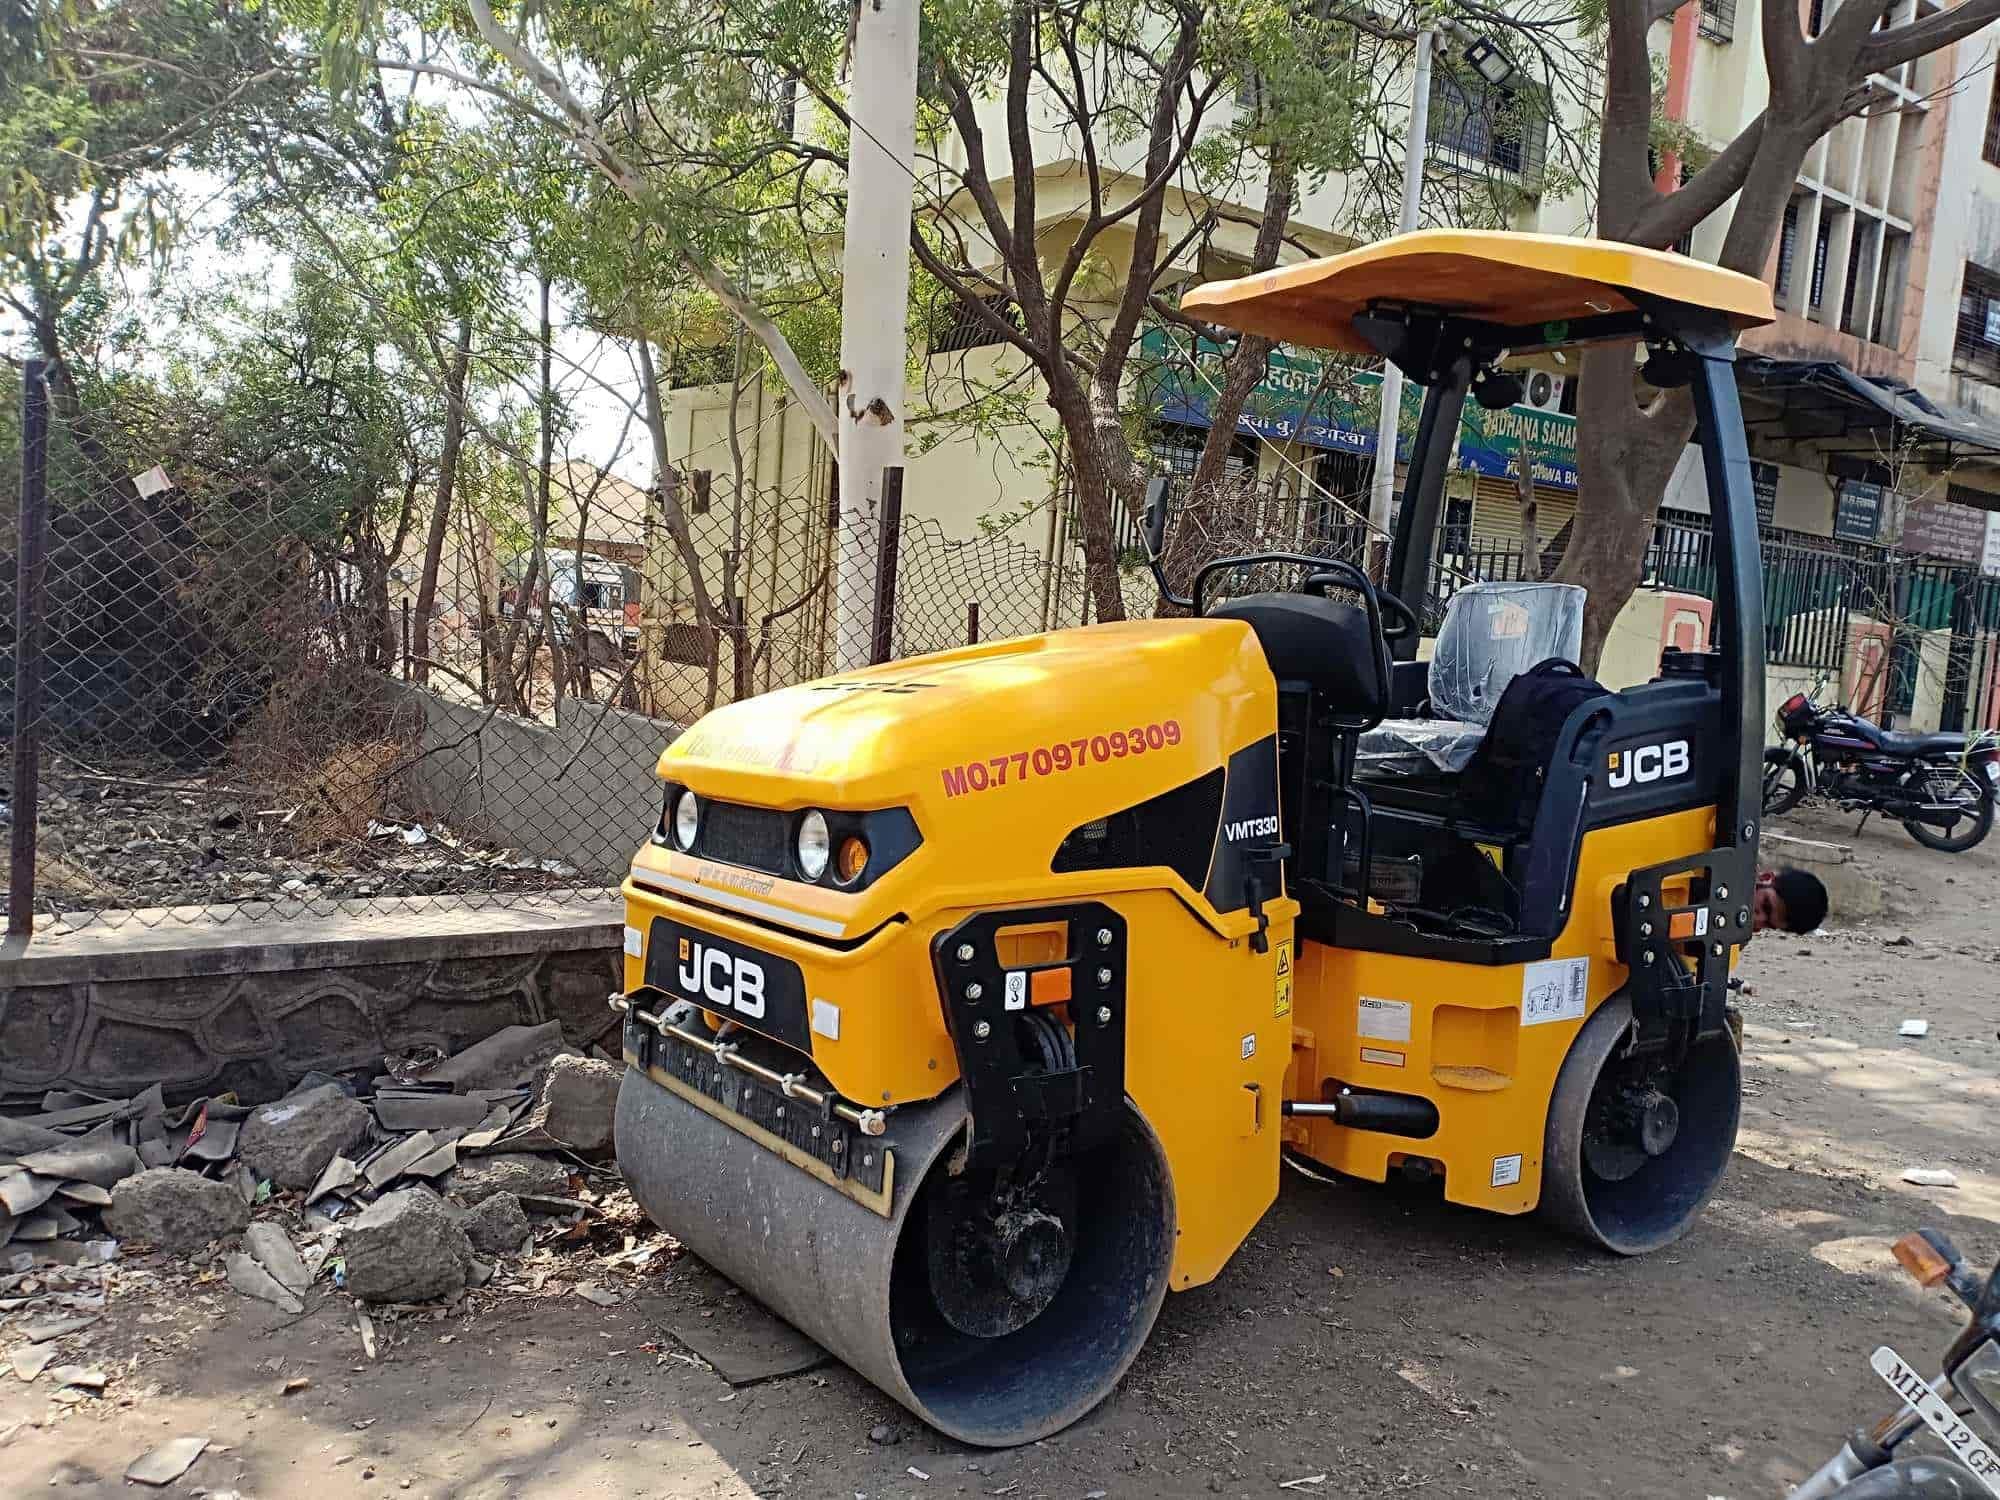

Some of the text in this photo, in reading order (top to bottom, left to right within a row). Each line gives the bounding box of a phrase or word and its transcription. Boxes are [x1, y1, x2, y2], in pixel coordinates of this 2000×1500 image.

[942, 719, 1182, 798] MO.7709709309
[1608, 740, 1690, 788] JCB
[1224, 815, 1278, 842] VMT330
[679, 941, 765, 1019] JCB
[1886, 1362, 1929, 1405] MH
[1943, 1421, 1971, 1450] 12
